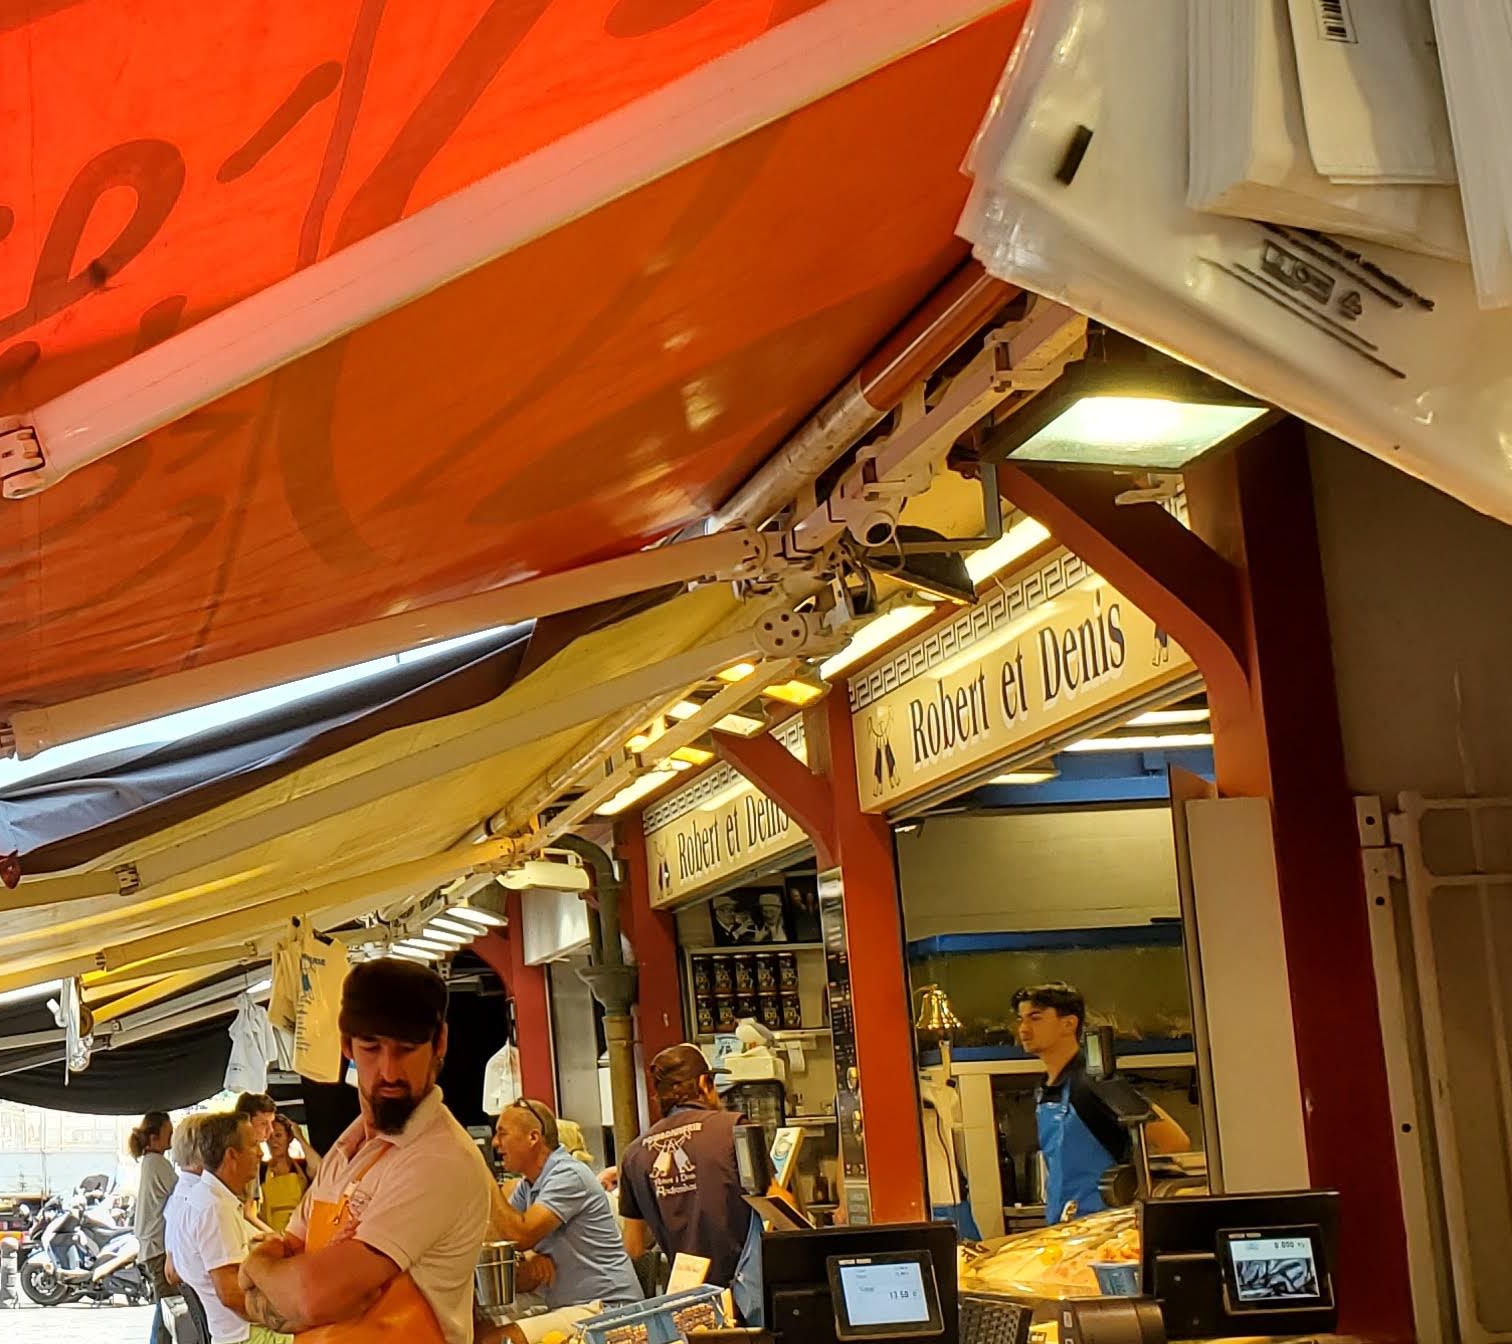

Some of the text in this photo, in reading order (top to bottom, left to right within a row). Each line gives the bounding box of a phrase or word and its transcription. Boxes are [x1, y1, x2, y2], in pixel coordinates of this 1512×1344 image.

[909, 589, 1126, 765] Robert et Denis
[678, 816, 721, 880] Robert
[726, 805, 740, 856] et
